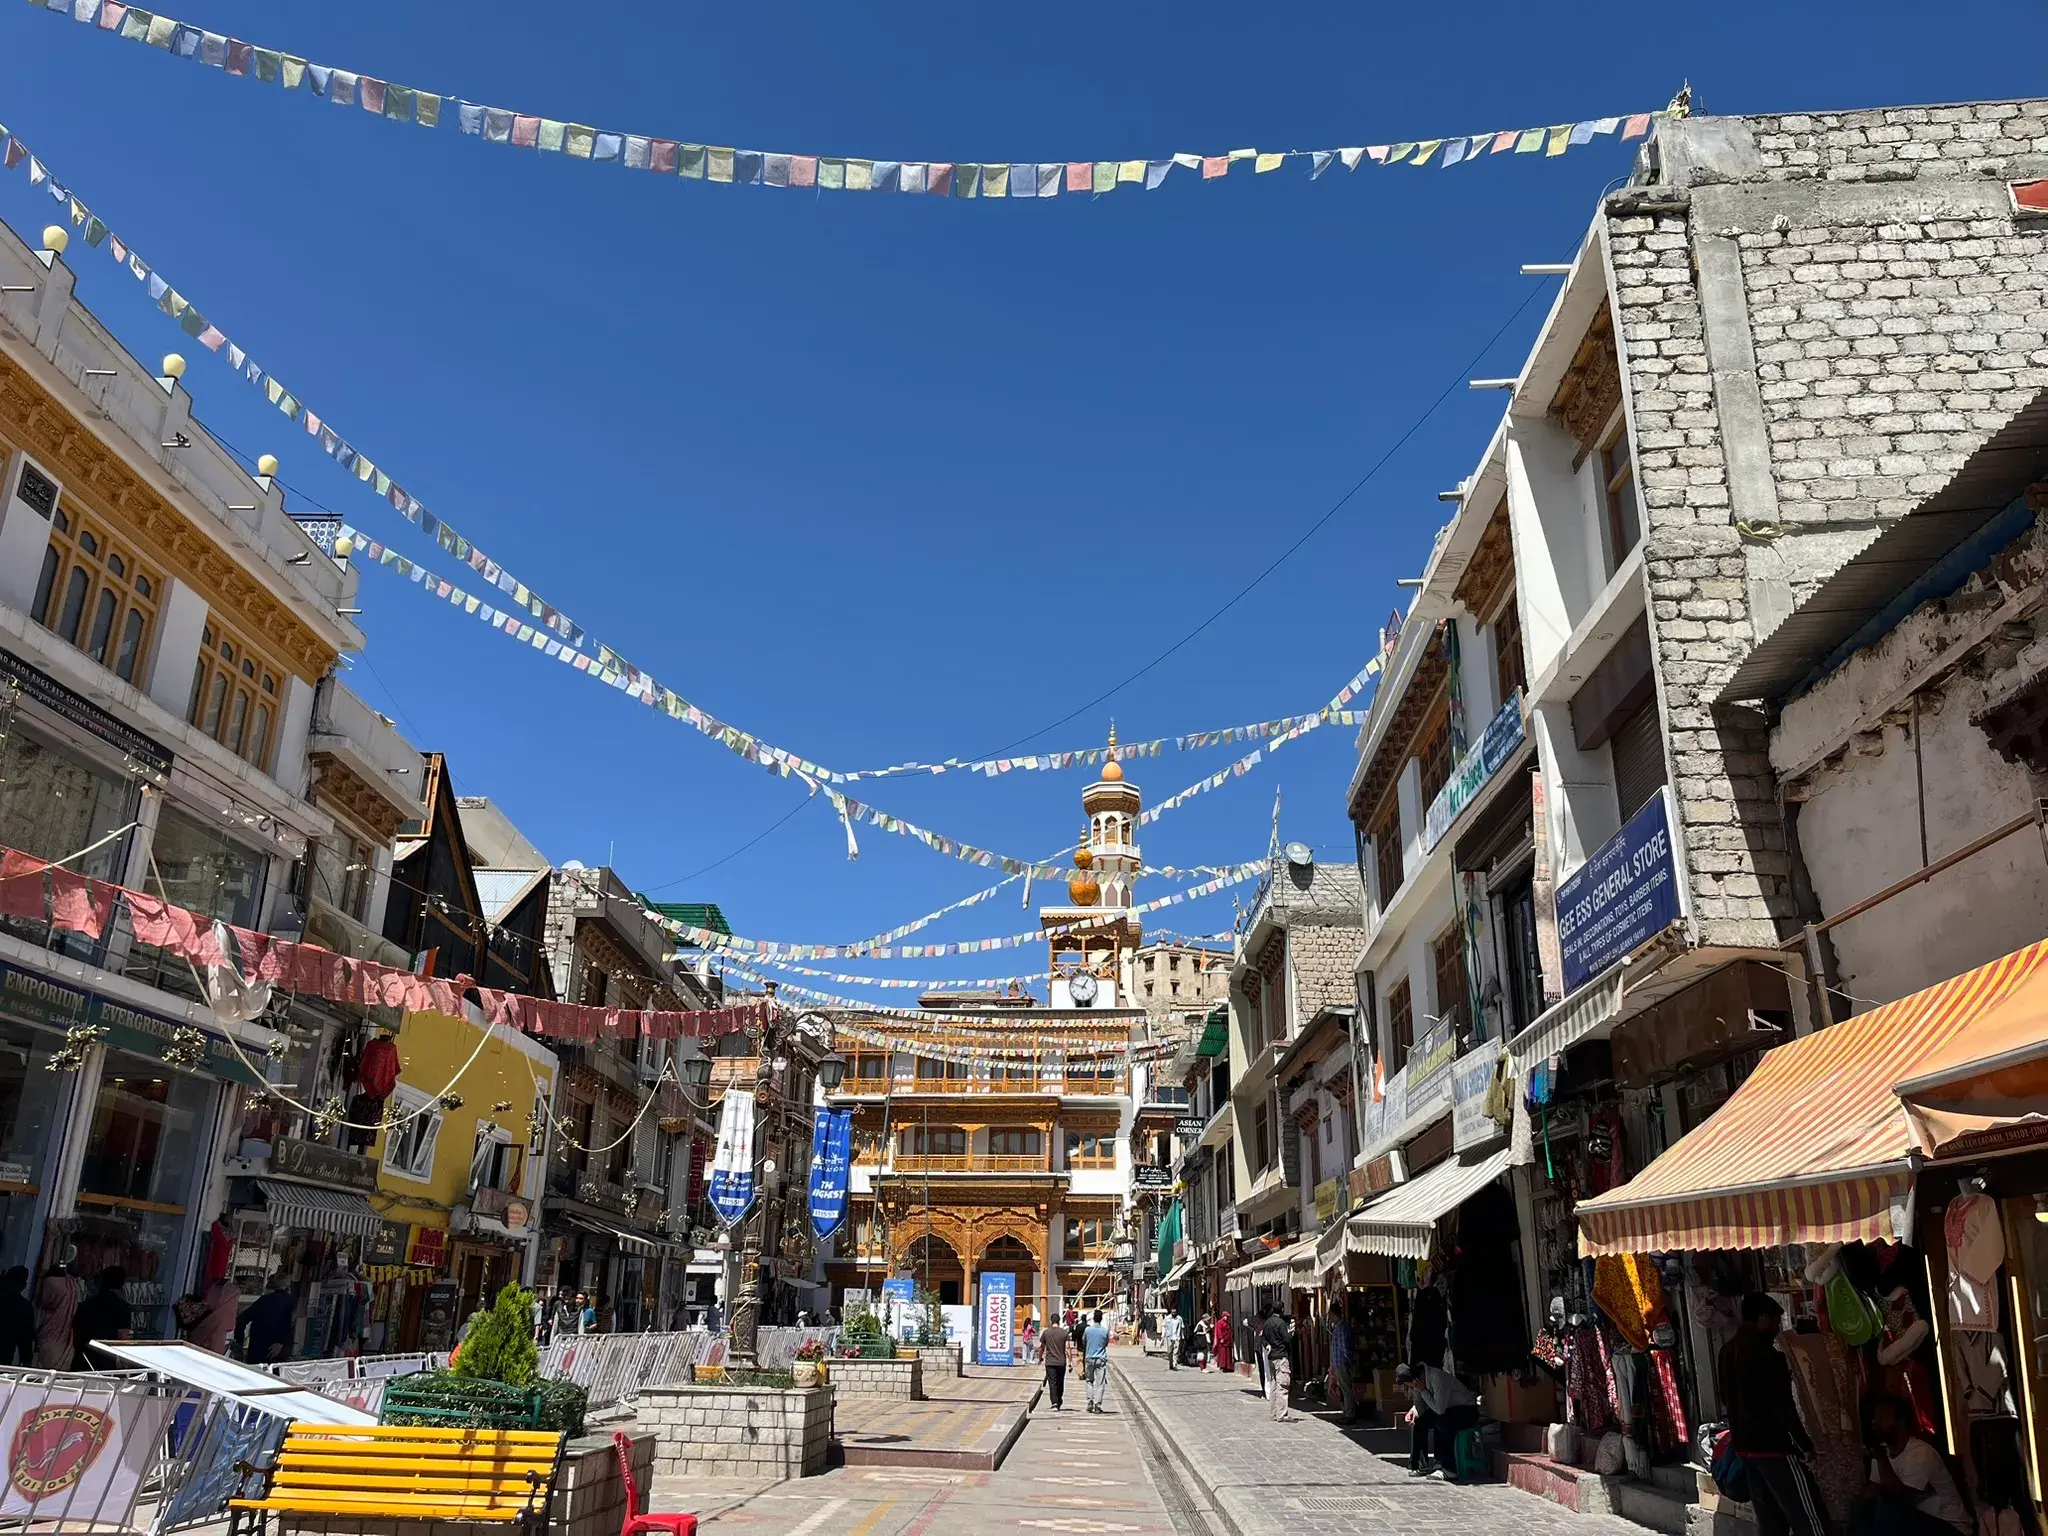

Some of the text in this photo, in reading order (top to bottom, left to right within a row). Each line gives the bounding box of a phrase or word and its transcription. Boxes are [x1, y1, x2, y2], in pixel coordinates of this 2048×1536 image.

[11, 660, 31, 677] MADE
[1559, 908, 1576, 940] GEE
[1575, 895, 1592, 927] ESS
[1592, 861, 1634, 912] GENERAL
[1633, 829, 1668, 877] STORE
[1563, 940, 1578, 959] DEALS
[1628, 881, 1651, 908] BARBER
[1582, 947, 1592, 961] ALL
[1590, 935, 1606, 955] TYPES
[1605, 930, 1612, 943] OF
[1612, 910, 1637, 938] COSMETIC
[1636, 899, 1653, 921] ITEMS
[4, 969, 85, 1012] EMPORIUM
[101, 1002, 177, 1042] EVERGREEN
[821, 1180, 835, 1190] THE
[989, 1296, 999, 1350] LADAKH
[999, 1296, 1008, 1350] MARATHON
